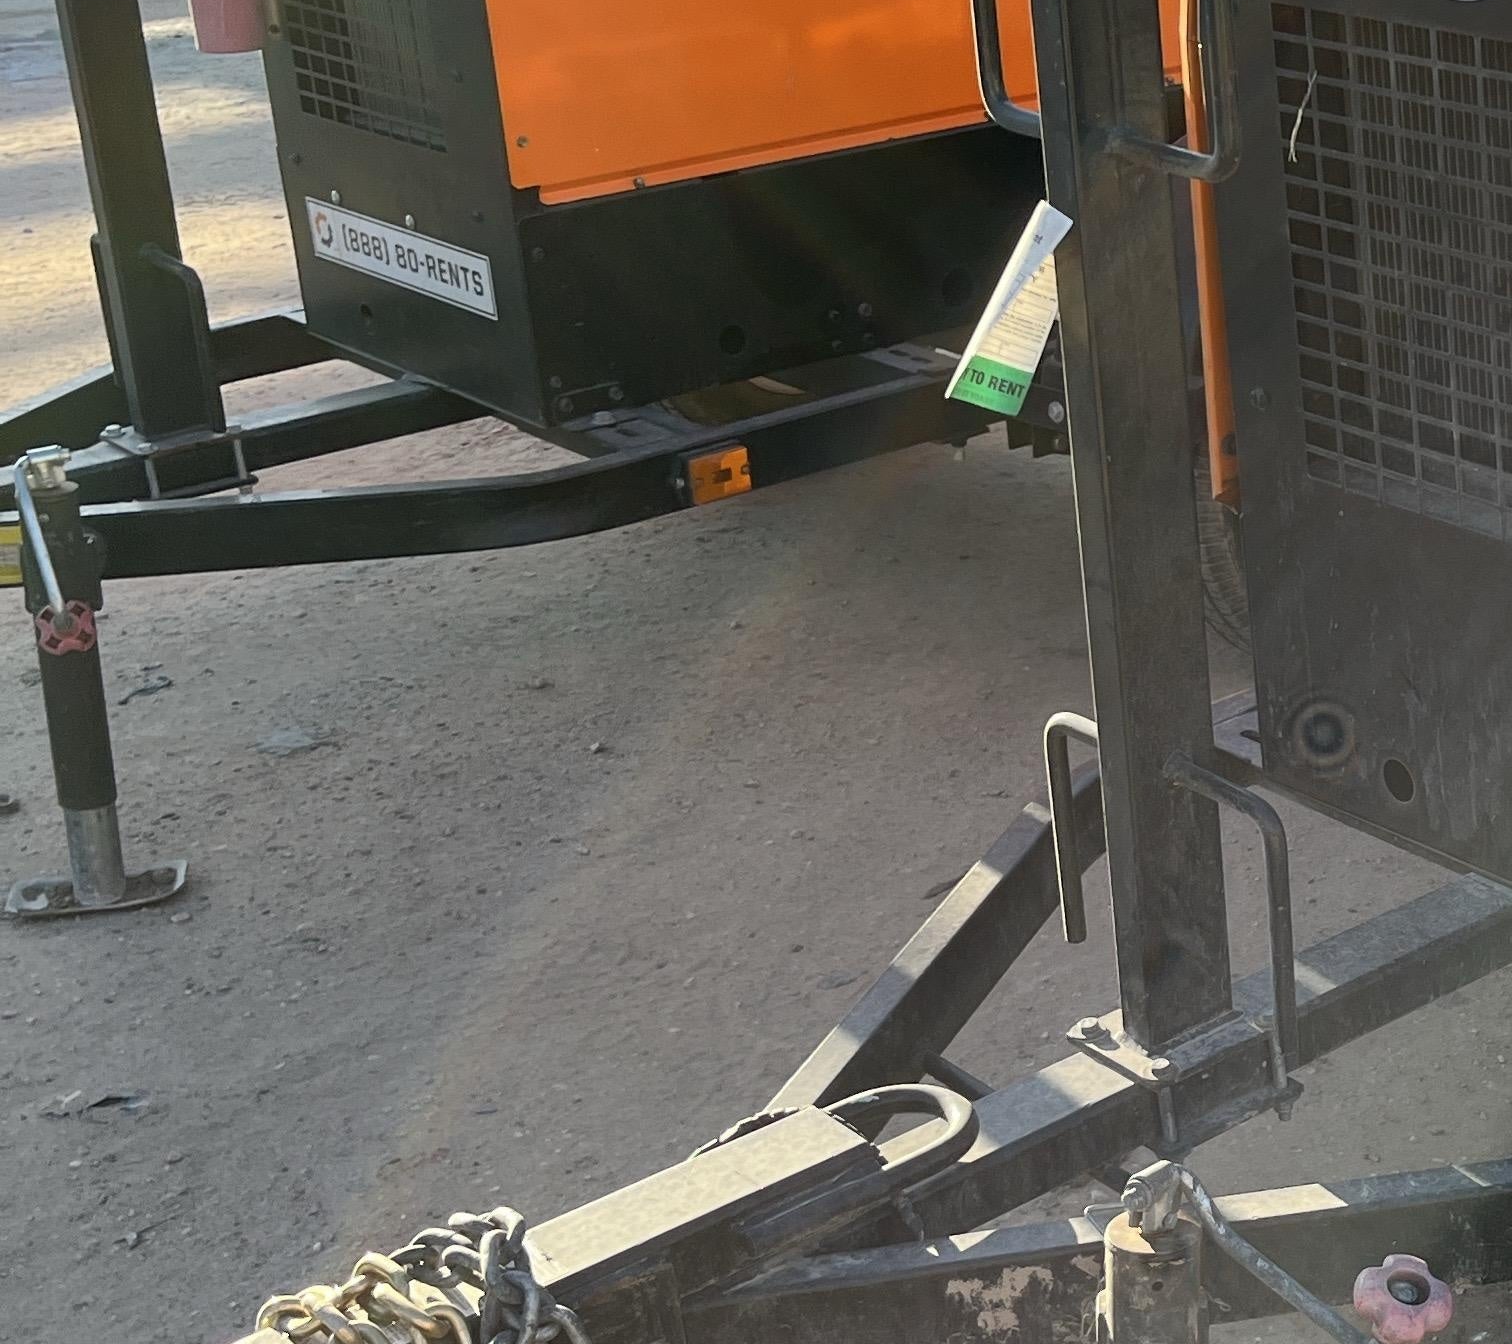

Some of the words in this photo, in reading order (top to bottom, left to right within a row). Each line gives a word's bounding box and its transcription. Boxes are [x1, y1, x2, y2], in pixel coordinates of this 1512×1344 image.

[341, 223, 391, 267] (888)
[394, 244, 485, 297] 80-RENTS
[969, 368, 985, 385] TO
[988, 375, 1026, 398] RENT
